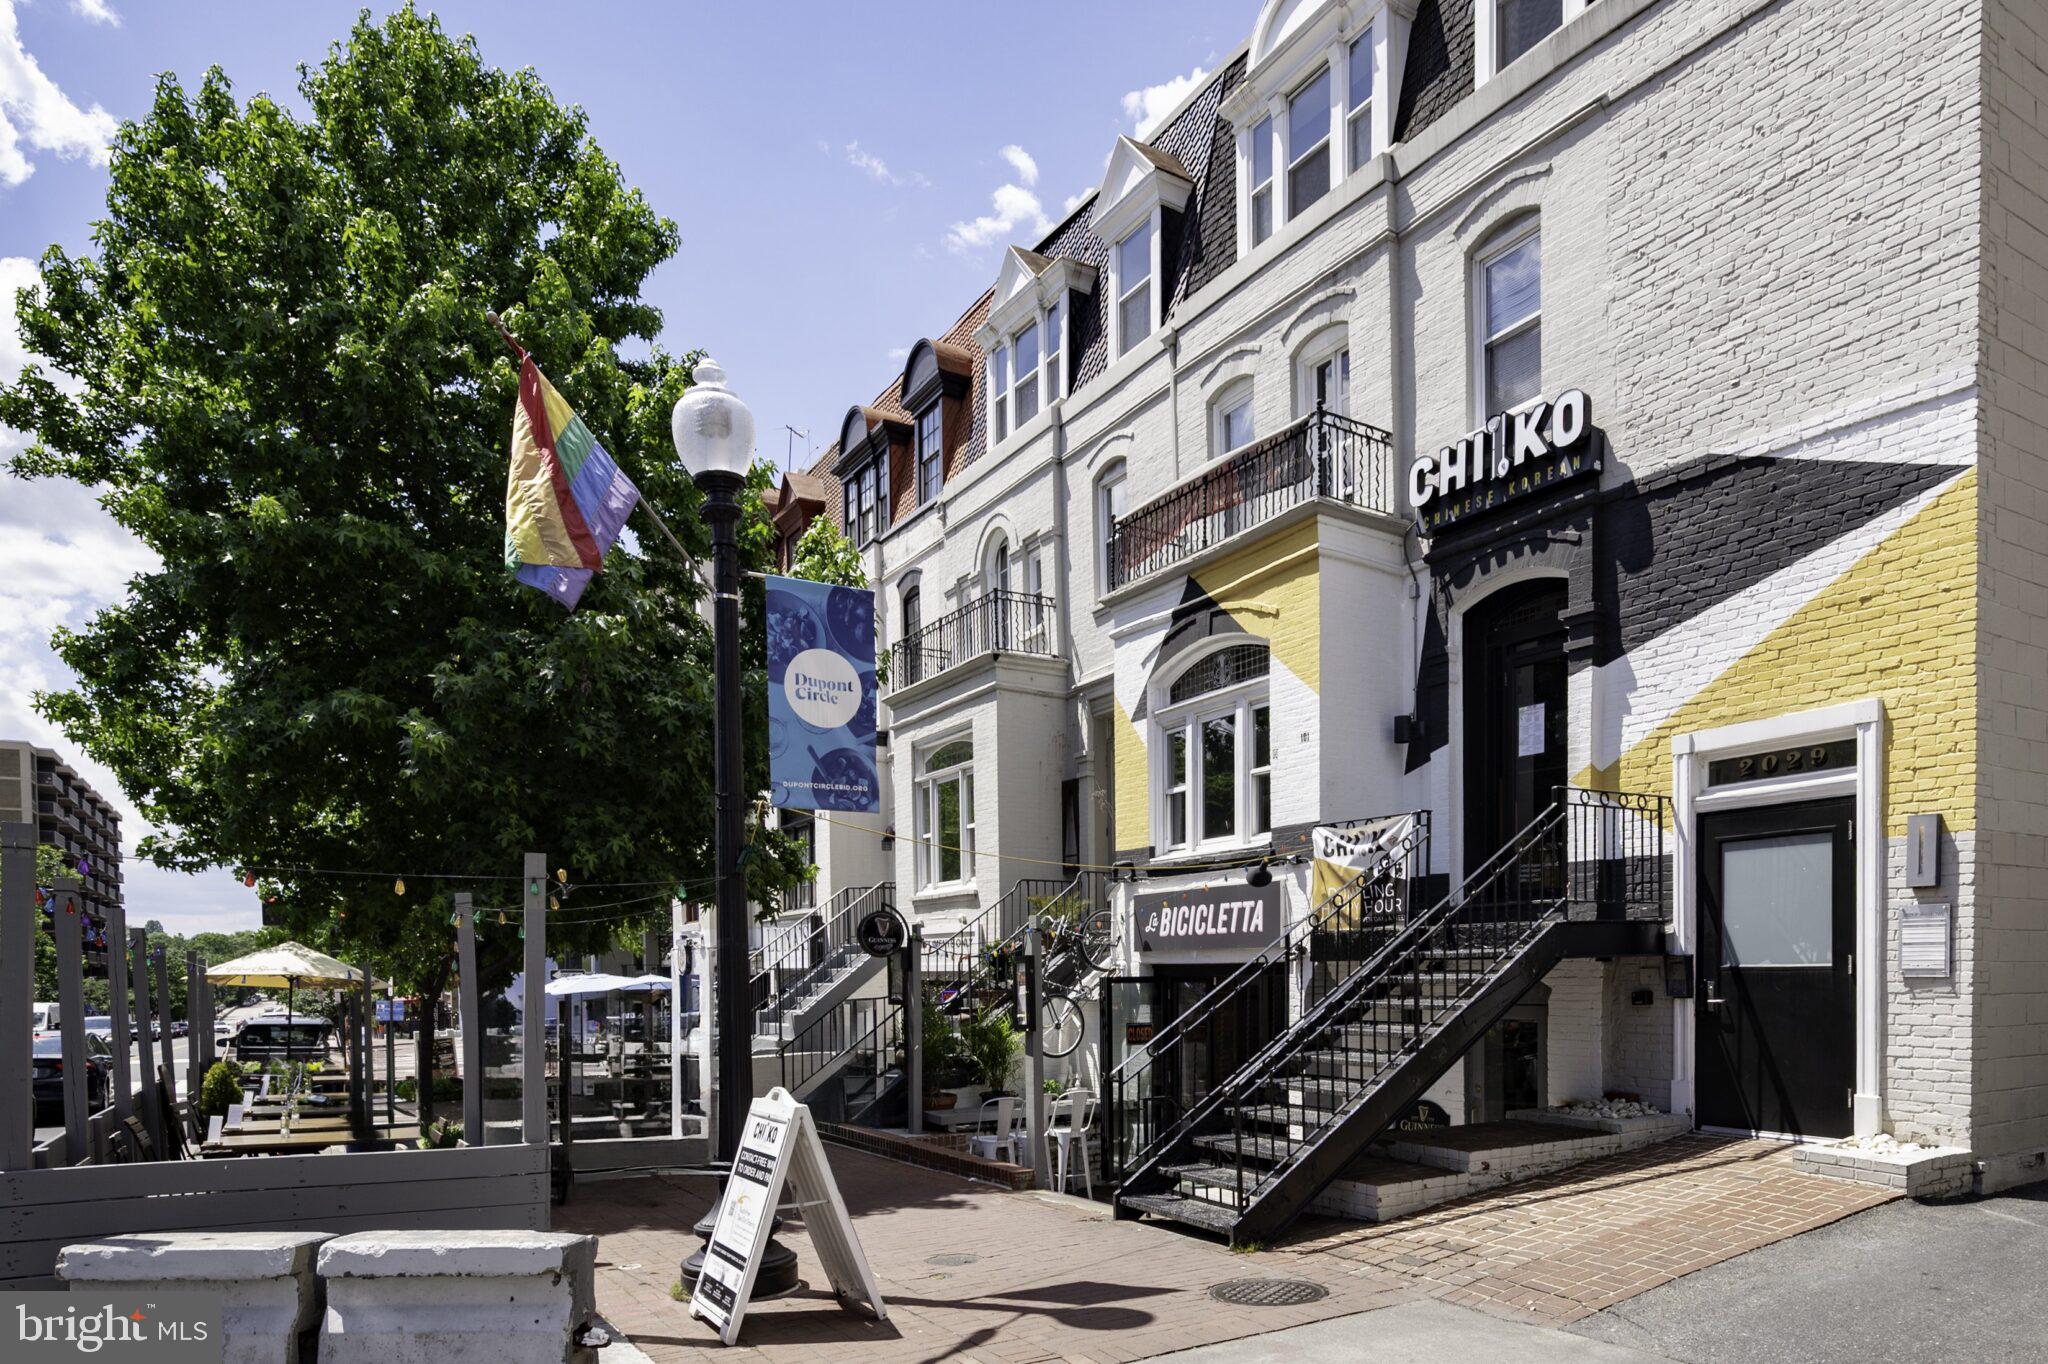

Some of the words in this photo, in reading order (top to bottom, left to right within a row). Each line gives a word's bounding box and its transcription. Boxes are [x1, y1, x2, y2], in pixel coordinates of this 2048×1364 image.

[1423, 489, 1495, 529] CHINESE
[1508, 455, 1582, 496] KOREAN
[794, 672, 854, 693] Dupont
[794, 687, 839, 705] Circle
[1739, 746, 1828, 778] 2029
[782, 780, 868, 793] DUPONTCIRCLEBID.ORG
[1363, 897, 1402, 914] HOUR
[1144, 911, 1159, 933] La
[1159, 899, 1264, 937] BICICLETTA
[868, 936, 897, 944] GUINNESS
[1127, 1026, 1153, 1042] CLOSED
[1400, 1119, 1445, 1132] GUINNE
